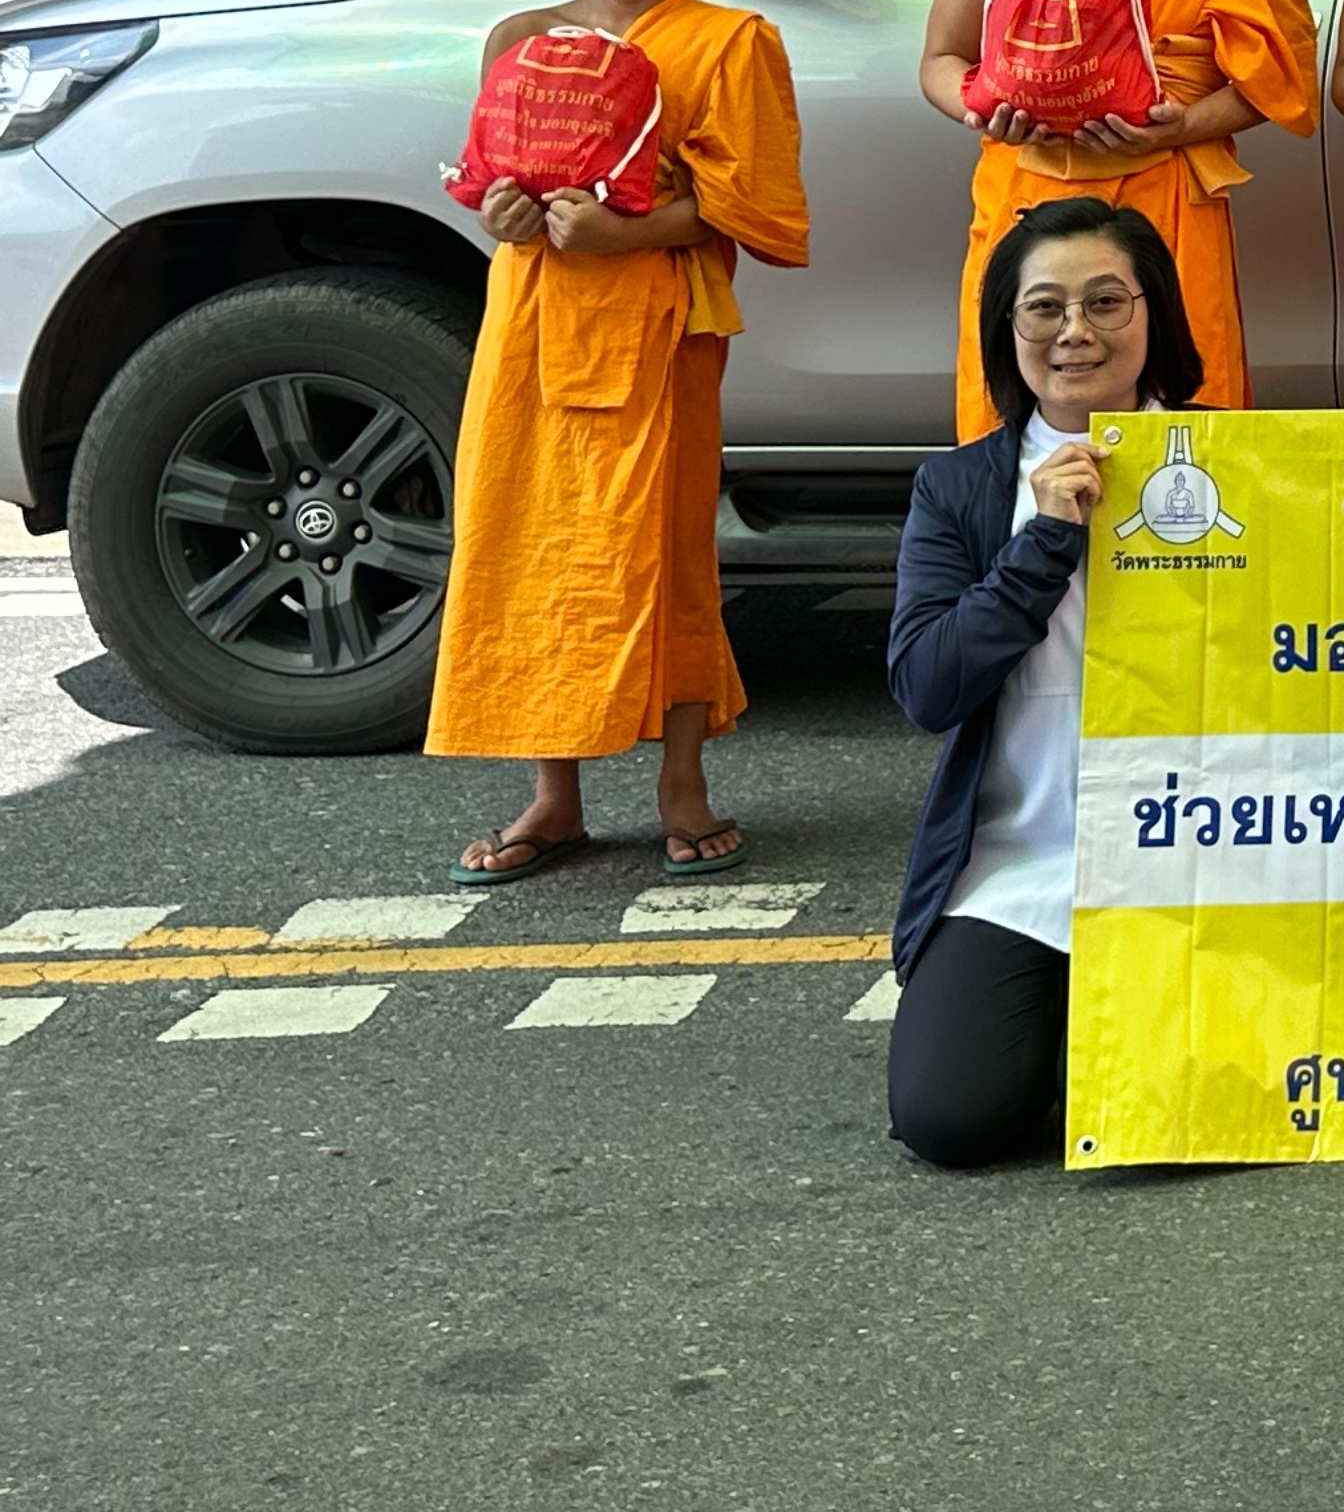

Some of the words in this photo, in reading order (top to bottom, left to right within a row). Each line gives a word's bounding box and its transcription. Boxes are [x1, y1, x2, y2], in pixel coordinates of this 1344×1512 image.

[1111, 550, 1248, 572] วัดพระธรรมกาย
